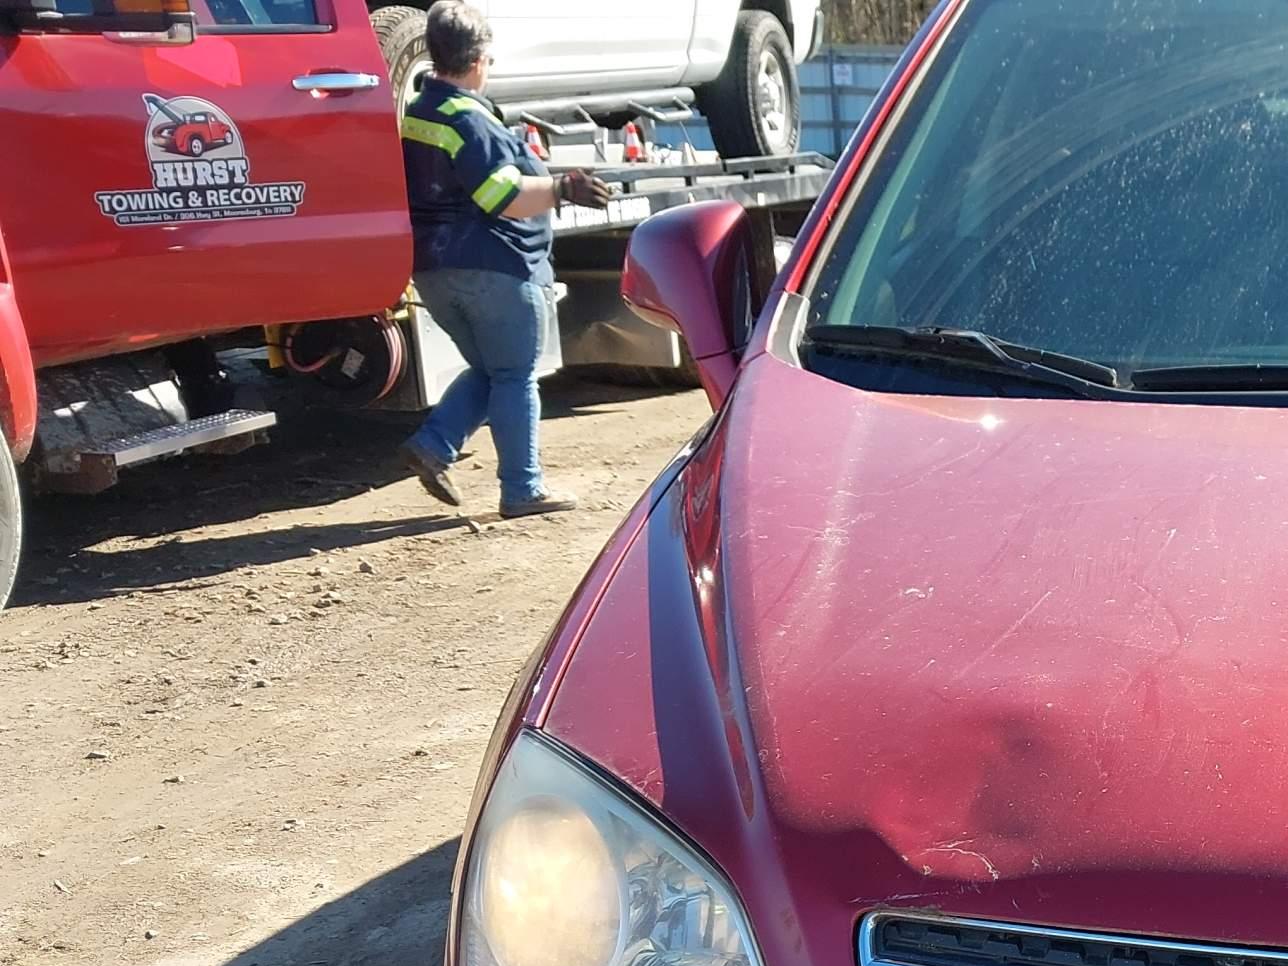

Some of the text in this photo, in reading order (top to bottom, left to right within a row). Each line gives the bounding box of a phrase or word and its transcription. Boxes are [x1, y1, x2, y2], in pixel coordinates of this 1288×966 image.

[153, 161, 247, 187] HURST
[98, 185, 303, 212] TOWING & RECOVERY
